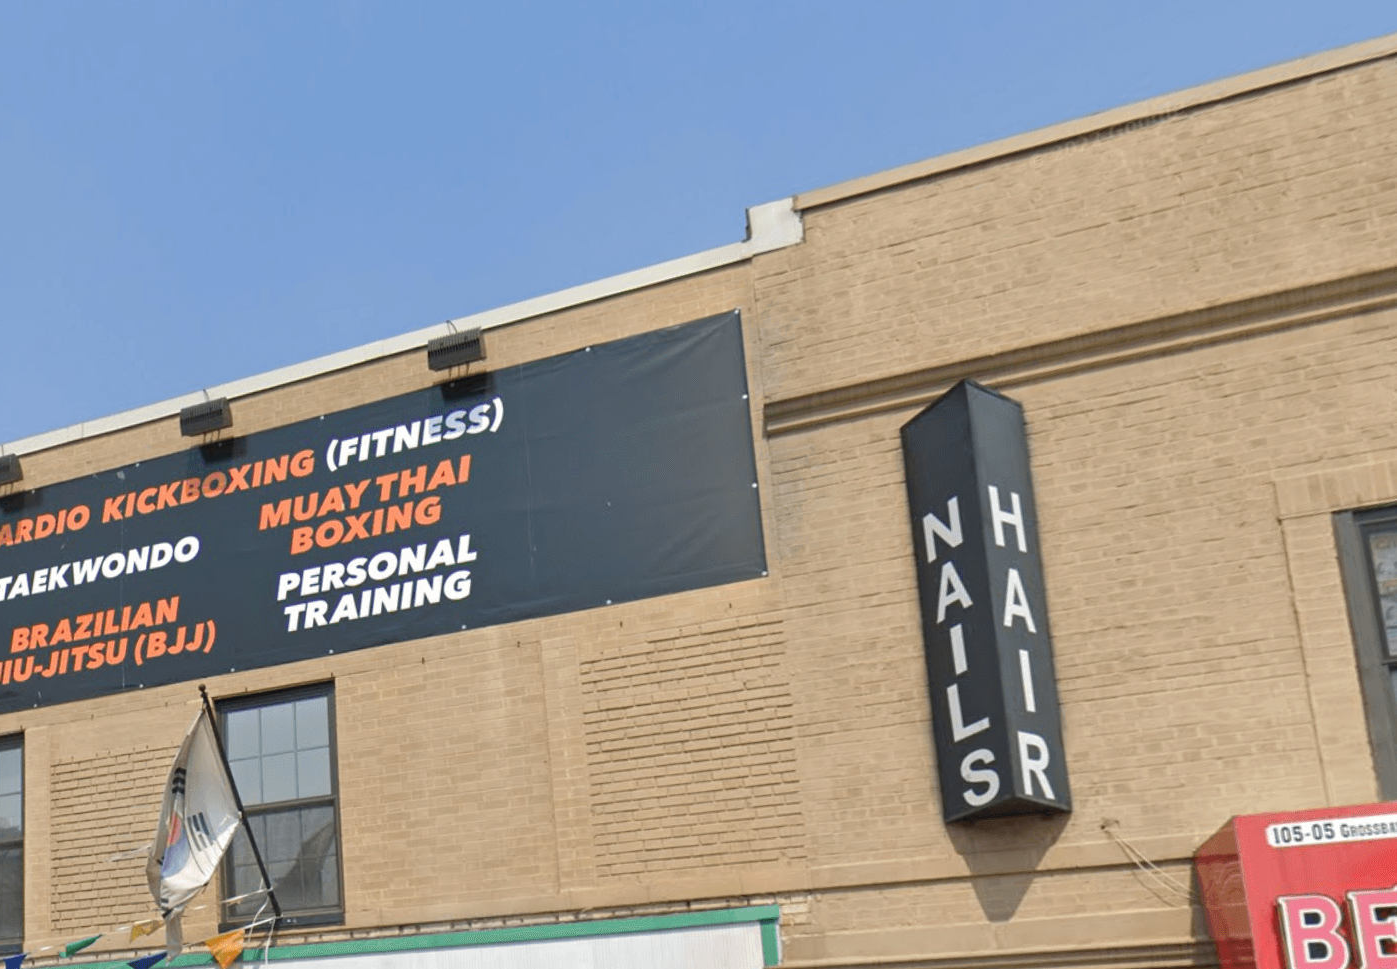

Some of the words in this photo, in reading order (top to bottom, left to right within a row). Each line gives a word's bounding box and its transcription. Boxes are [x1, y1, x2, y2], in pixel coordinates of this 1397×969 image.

[101, 449, 315, 524] KICKBOXING
[326, 397, 504, 471] (FITNESS)
[258, 476, 373, 531] MUAY
[376, 455, 472, 501] THAI
[290, 496, 442, 554] BOXING
[277, 534, 478, 601] PERSONAL
[10, 596, 179, 654] BRAZILIAN
[284, 570, 472, 632] TRAINING
[134, 619, 216, 667] (BJJ)
[922, 496, 1001, 807] NAILS
[988, 485, 1056, 800] HAIR
[1272, 823, 1335, 844] 105-05
